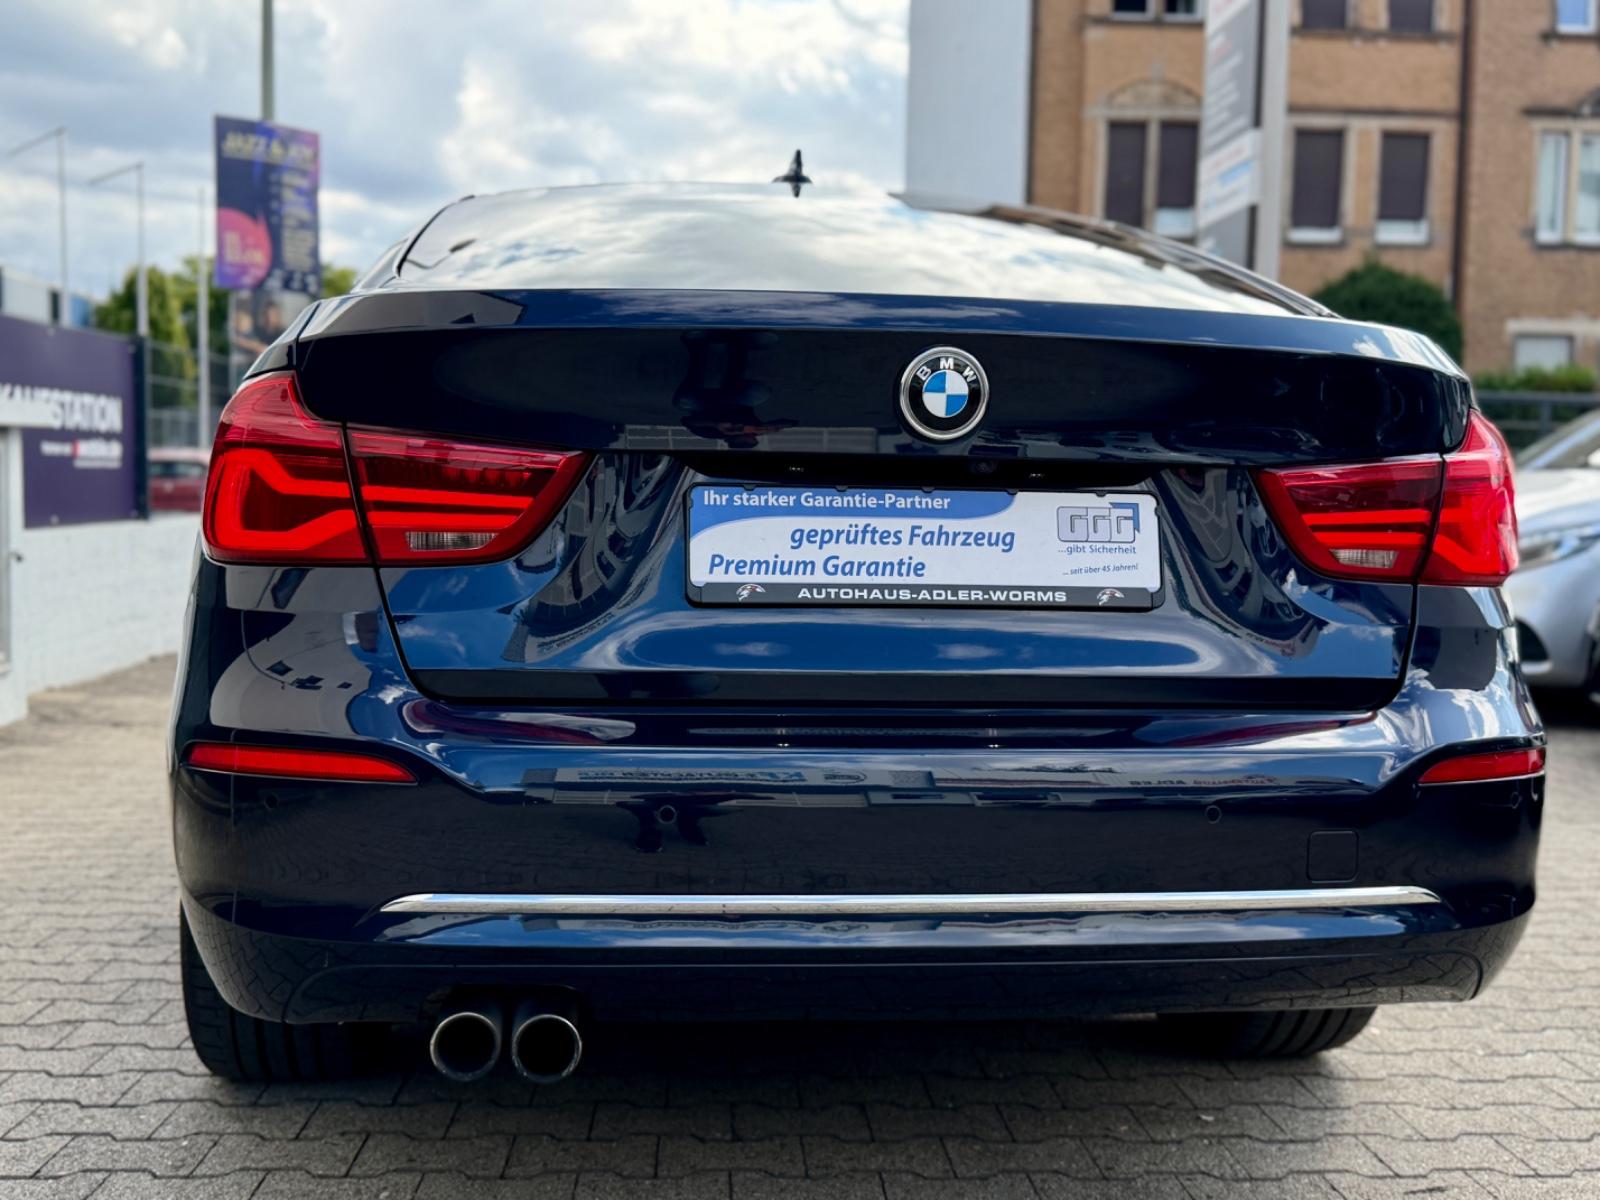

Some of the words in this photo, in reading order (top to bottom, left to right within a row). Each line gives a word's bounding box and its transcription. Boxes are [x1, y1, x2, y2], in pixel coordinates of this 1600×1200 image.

[916, 358, 976, 382] BMW
[703, 490, 728, 506] Ihr
[733, 491, 796, 507] starker
[800, 492, 951, 509] Garantie-Partner
[789, 523, 903, 550] geprüftes
[908, 525, 1015, 551] Fahrzeug
[1089, 544, 1137, 555] Sicherheit
[708, 554, 816, 576] Premium
[822, 555, 926, 578] Garantie
[1084, 566, 1100, 574] über
[797, 587, 1067, 602] AUTOHAUS-ADLER-WORMS
